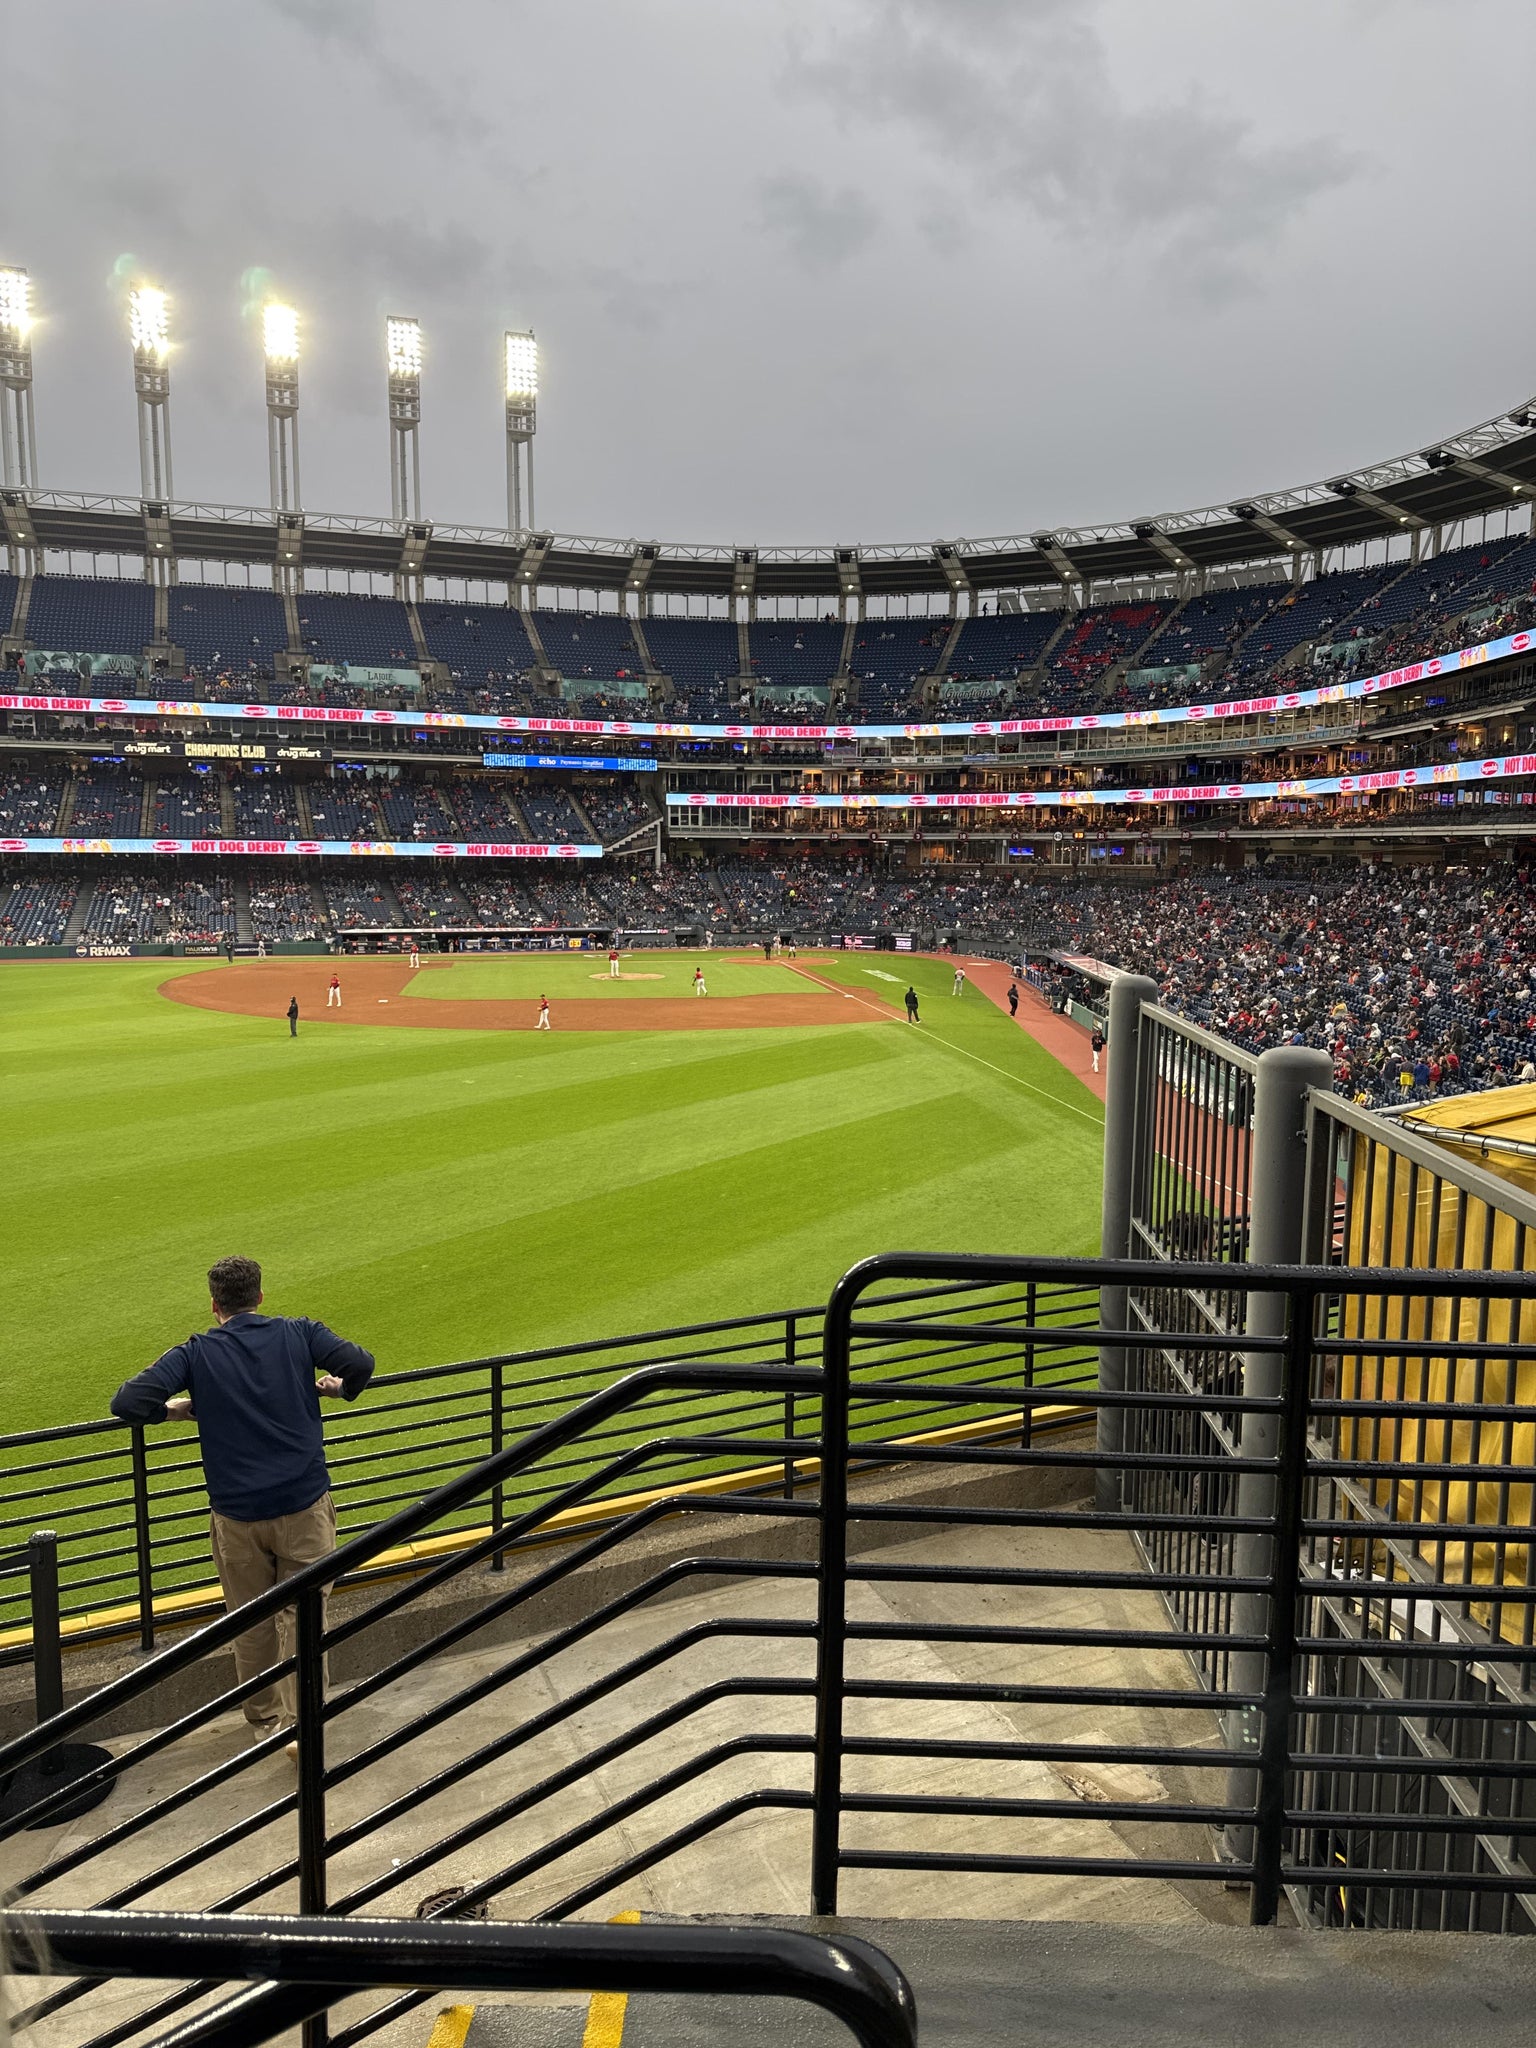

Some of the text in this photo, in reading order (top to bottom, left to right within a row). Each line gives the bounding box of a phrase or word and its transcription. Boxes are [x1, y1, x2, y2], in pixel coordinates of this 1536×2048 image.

[1378, 674, 1391, 689] HOT
[1391, 670, 1403, 686] DOG
[1404, 663, 1424, 683] DERBY
[945, 687, 992, 700] Guardians
[22, 697, 49, 709] DOG
[51, 698, 92, 710] DERBY
[1213, 703, 1232, 716] HOT
[1232, 701, 1251, 714] DOG
[1251, 697, 1278, 712] DERBY
[277, 707, 300, 719] HOT
[302, 708, 327, 720] DOG
[328, 709, 365, 721] DERBY
[527, 719, 548, 730] HOT
[550, 720, 571, 731] DOG
[573, 721, 605, 732] DERBY
[752, 726, 773, 737] HOT
[775, 726, 795, 737] DOG
[797, 726, 828, 737] DERBY
[1000, 721, 1019, 732] HOT
[1020, 720, 1041, 732] DOG
[1042, 718, 1073, 731] DERBY
[124, 744, 172, 755] drug mart
[184, 743, 266, 759] CHAMPIONS CLUB
[276, 749, 299, 759] drug
[299, 750, 322, 758] mart
[1504, 758, 1521, 774] HOT
[1522, 755, 1536, 773] DO
[1358, 776, 1370, 790] HOT
[1370, 774, 1382, 788] DOG
[1382, 772, 1401, 787] DERBY
[936, 795, 955, 806] HOT
[957, 795, 977, 805] DOG
[979, 793, 1010, 805] DERBY
[1152, 789, 1171, 800] HOT
[1172, 788, 1191, 800] DOG
[1192, 786, 1220, 799] DERBY
[716, 795, 736, 805] HOT
[737, 795, 757, 806] DOG
[759, 795, 790, 806] DERBY
[191, 840, 217, 852] HOT
[218, 841, 246, 853] DOG
[248, 841, 287, 853] DERBY
[467, 844, 488, 856] HOT
[490, 845, 513, 856] DOG
[516, 845, 550, 856] DERBY
